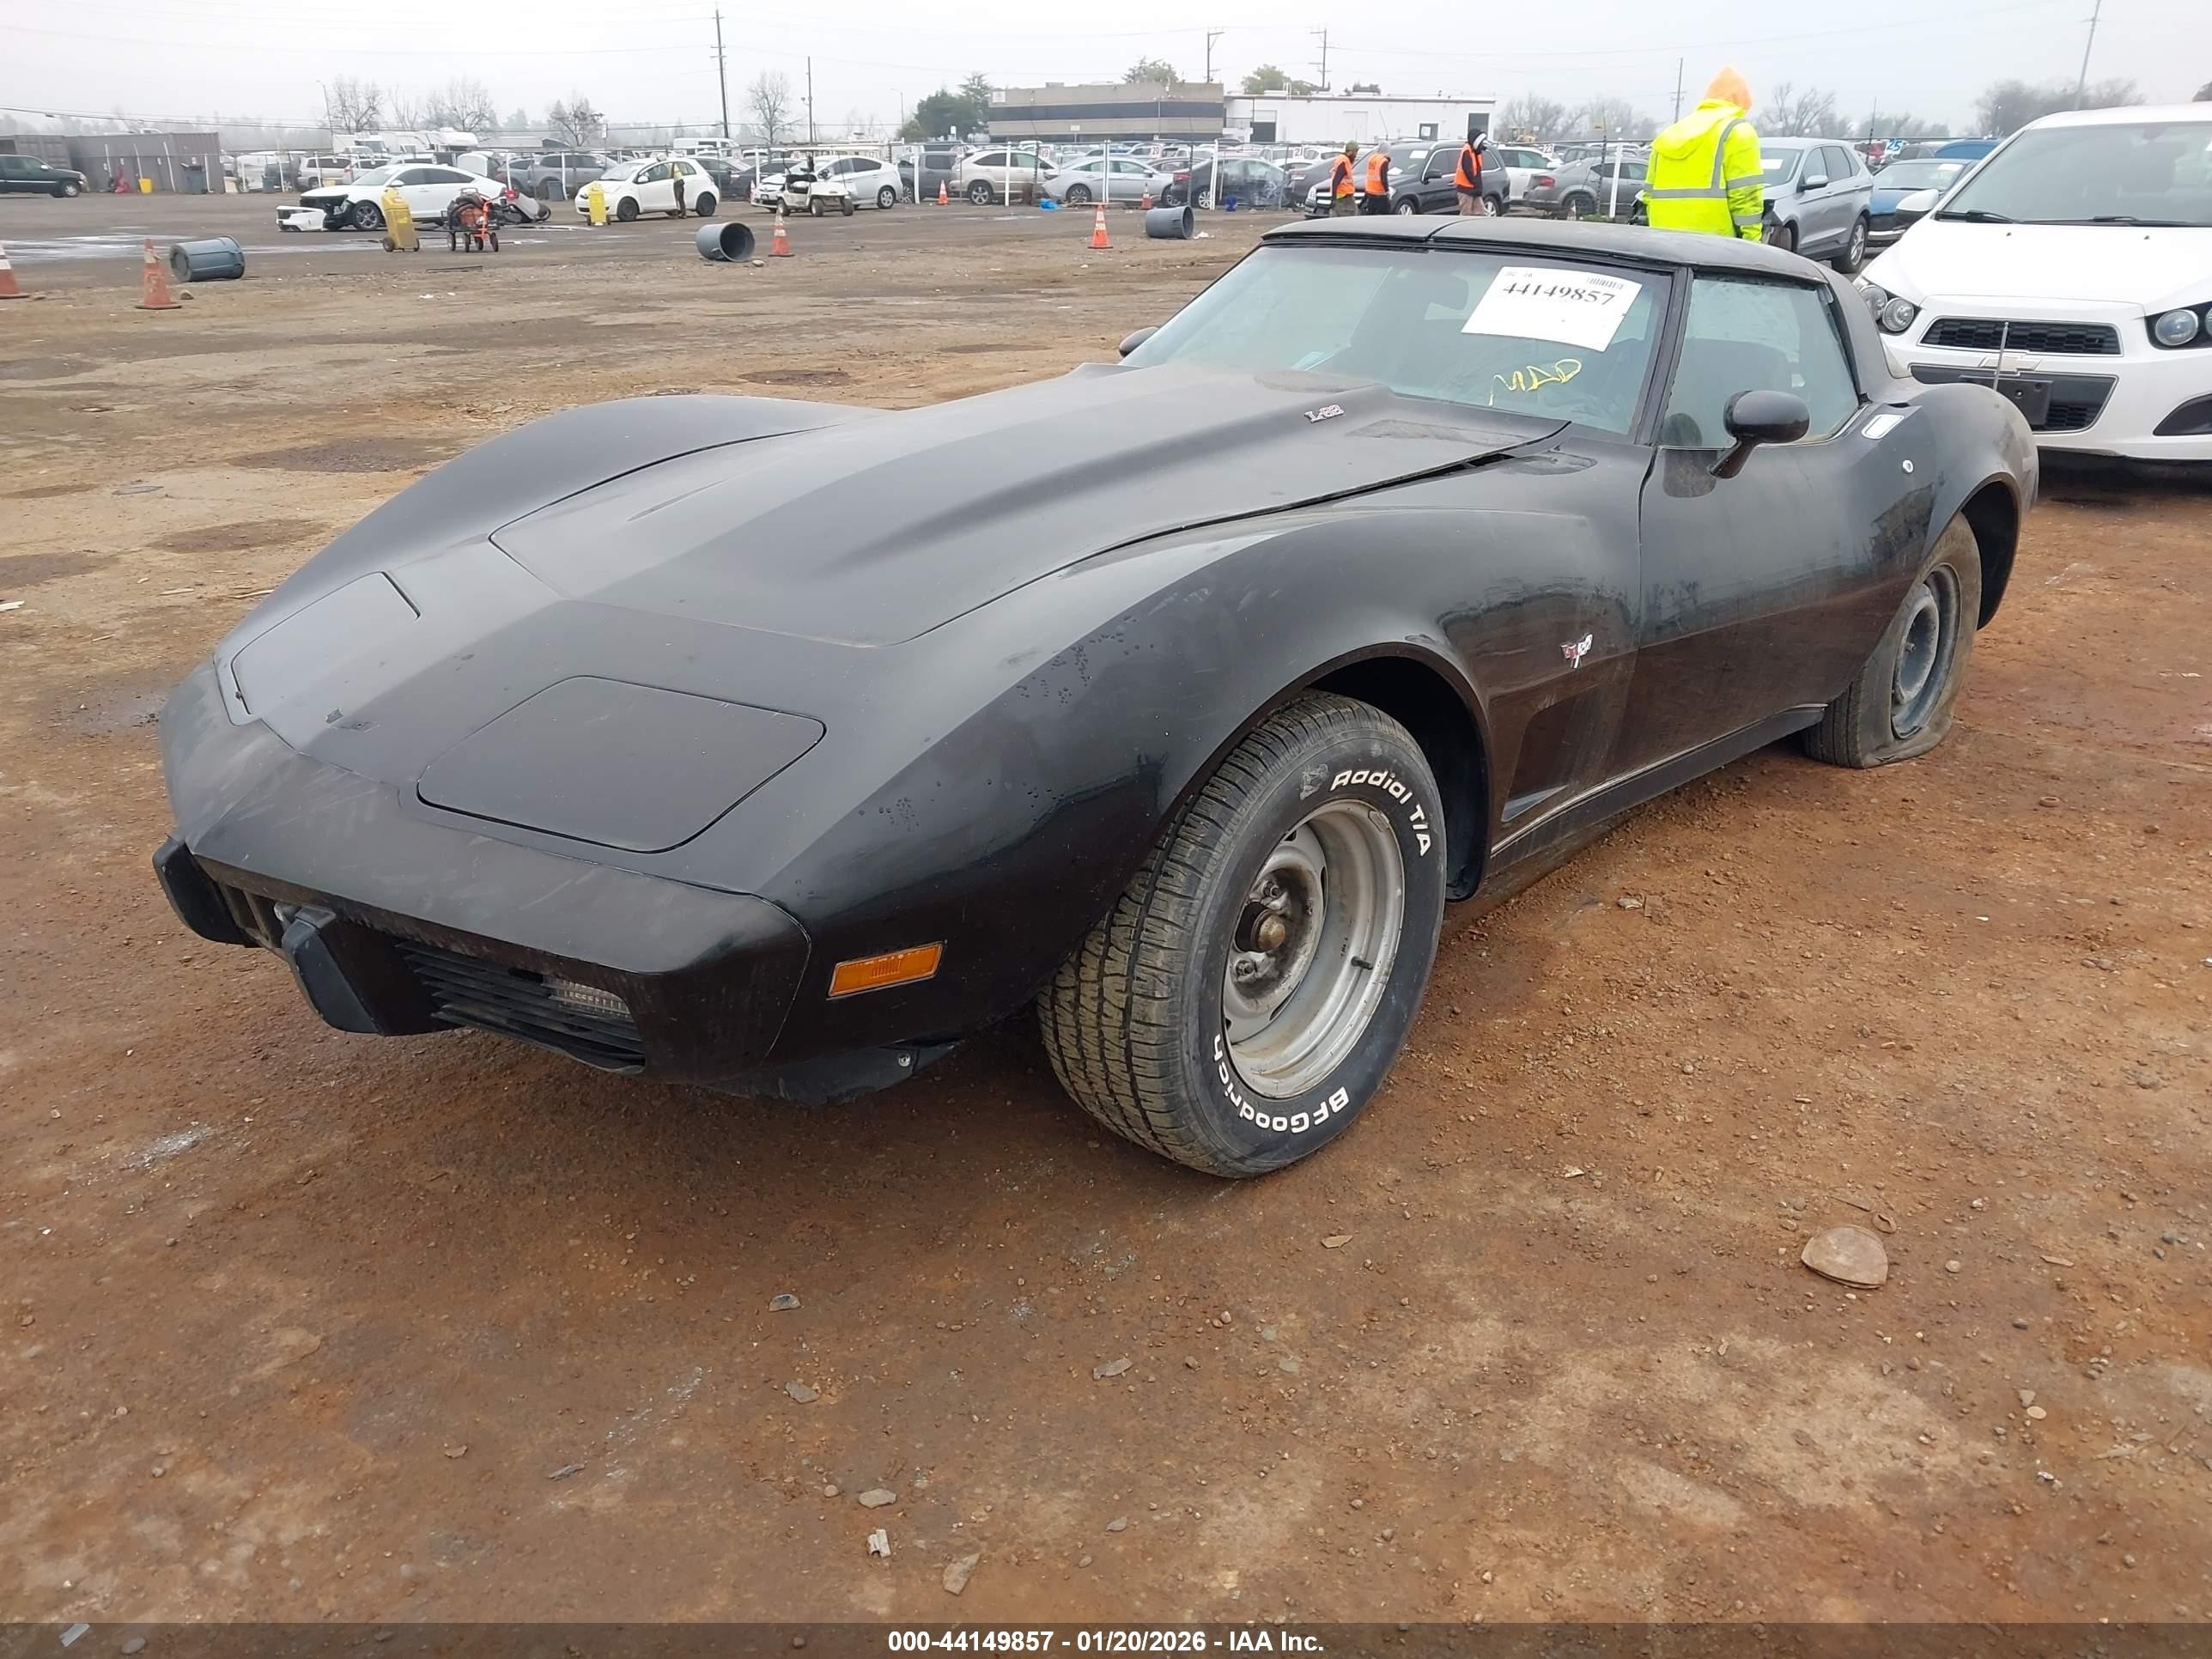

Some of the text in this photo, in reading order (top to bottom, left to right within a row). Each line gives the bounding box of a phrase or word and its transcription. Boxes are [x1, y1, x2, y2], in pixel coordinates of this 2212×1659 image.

[1294, 147, 1304, 157] 21
[1503, 283, 1615, 306] 44149857
[1329, 769, 1431, 857] Radial T/A
[1213, 1033, 1350, 1133] BFGoodrich
